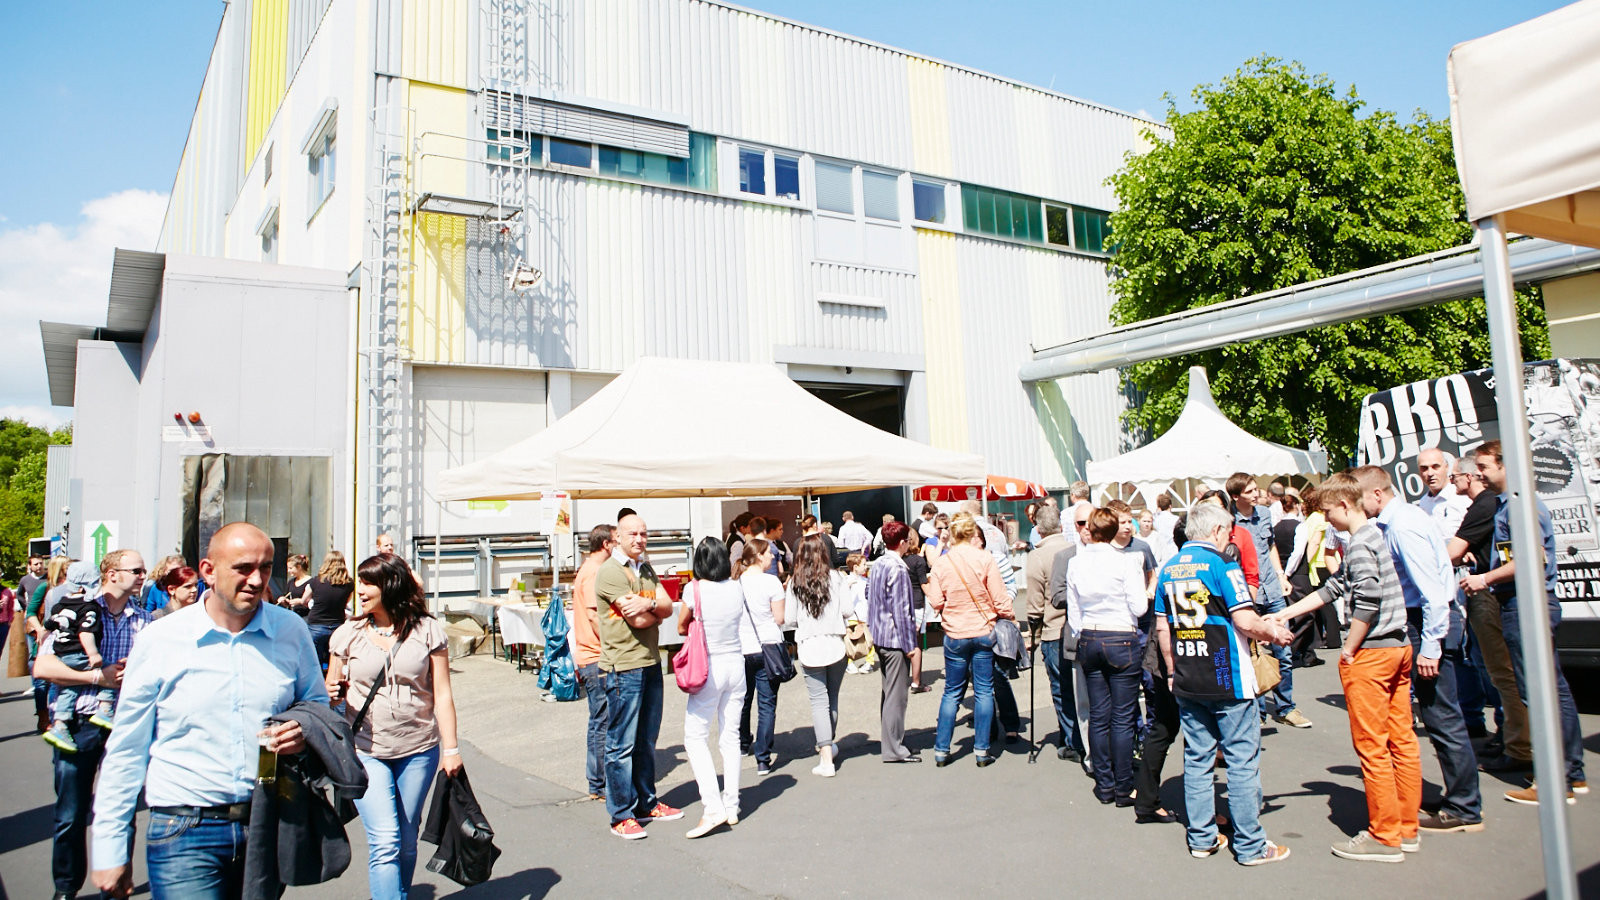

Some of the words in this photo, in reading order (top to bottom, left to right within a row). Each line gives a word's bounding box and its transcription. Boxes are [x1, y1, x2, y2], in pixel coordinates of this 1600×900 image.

[1357, 374, 1482, 467] BBQ
[1549, 504, 1588, 521] BERT
[1554, 519, 1591, 534] EYER
[1557, 568, 1600, 580] ERMAN
[1554, 580, 1600, 599] Q37.D
[1163, 579, 1208, 629] 15
[1176, 641, 1209, 657] GBR
